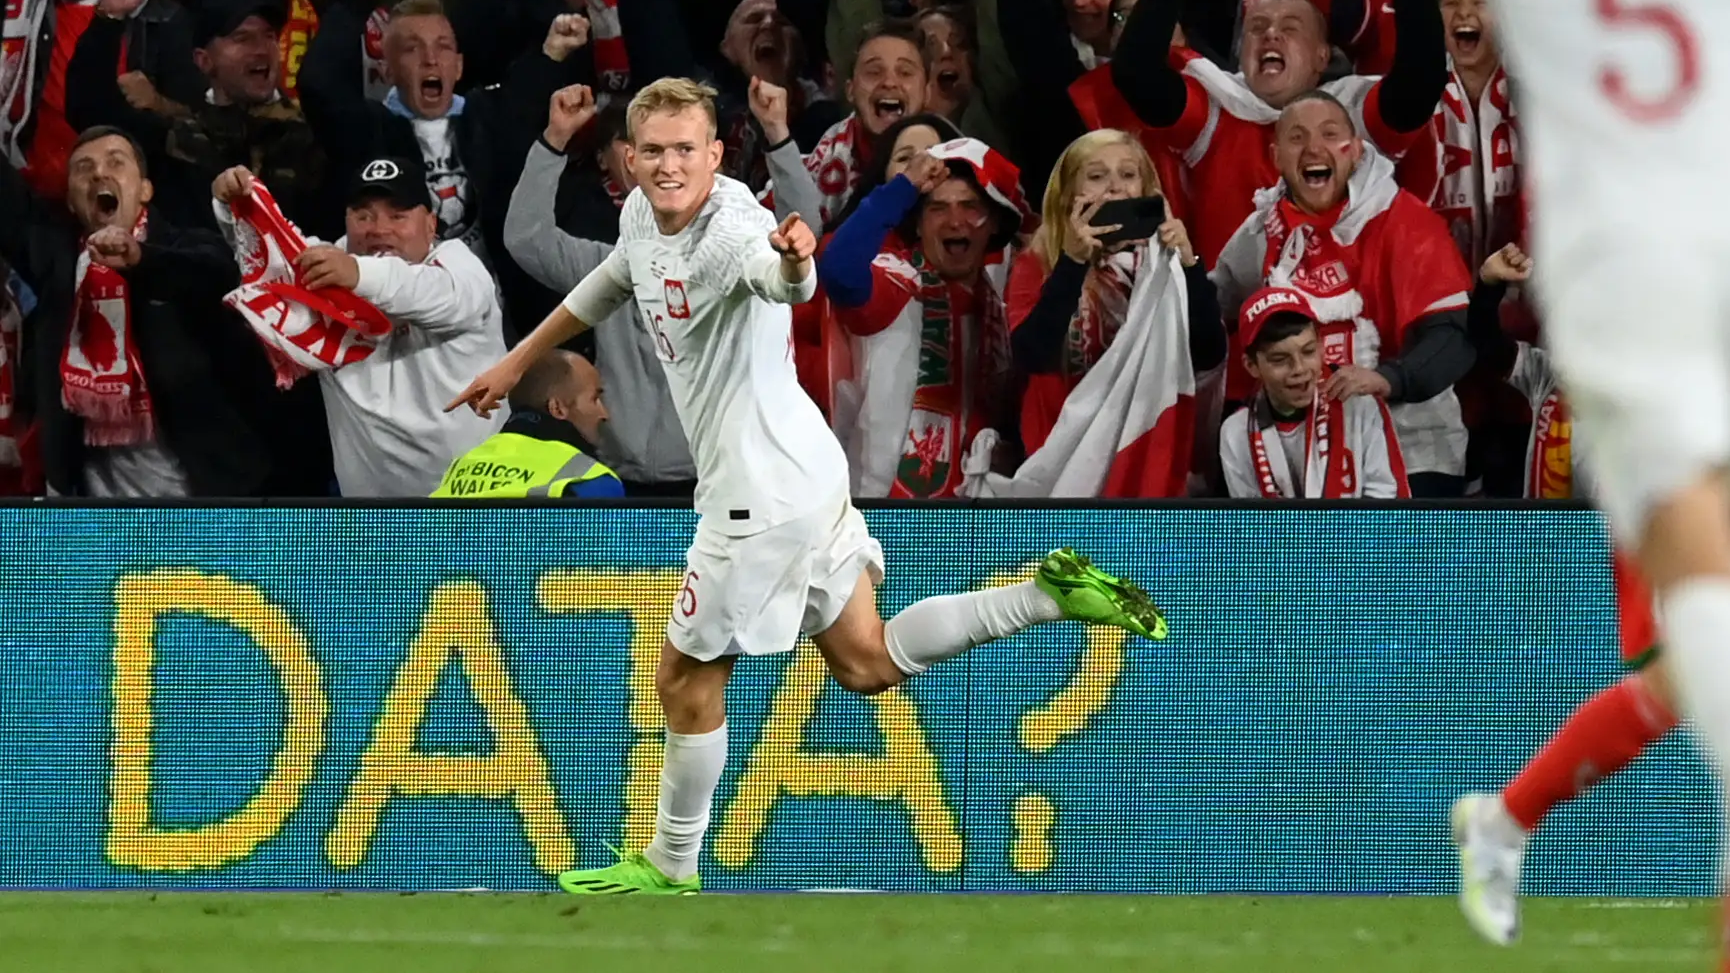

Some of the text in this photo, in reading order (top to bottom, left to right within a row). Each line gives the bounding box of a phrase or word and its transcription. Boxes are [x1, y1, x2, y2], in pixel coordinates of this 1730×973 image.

[1245, 291, 1301, 324] POLSKA
[455, 461, 535, 484] RBICON
[106, 566, 1128, 875] DATA?
